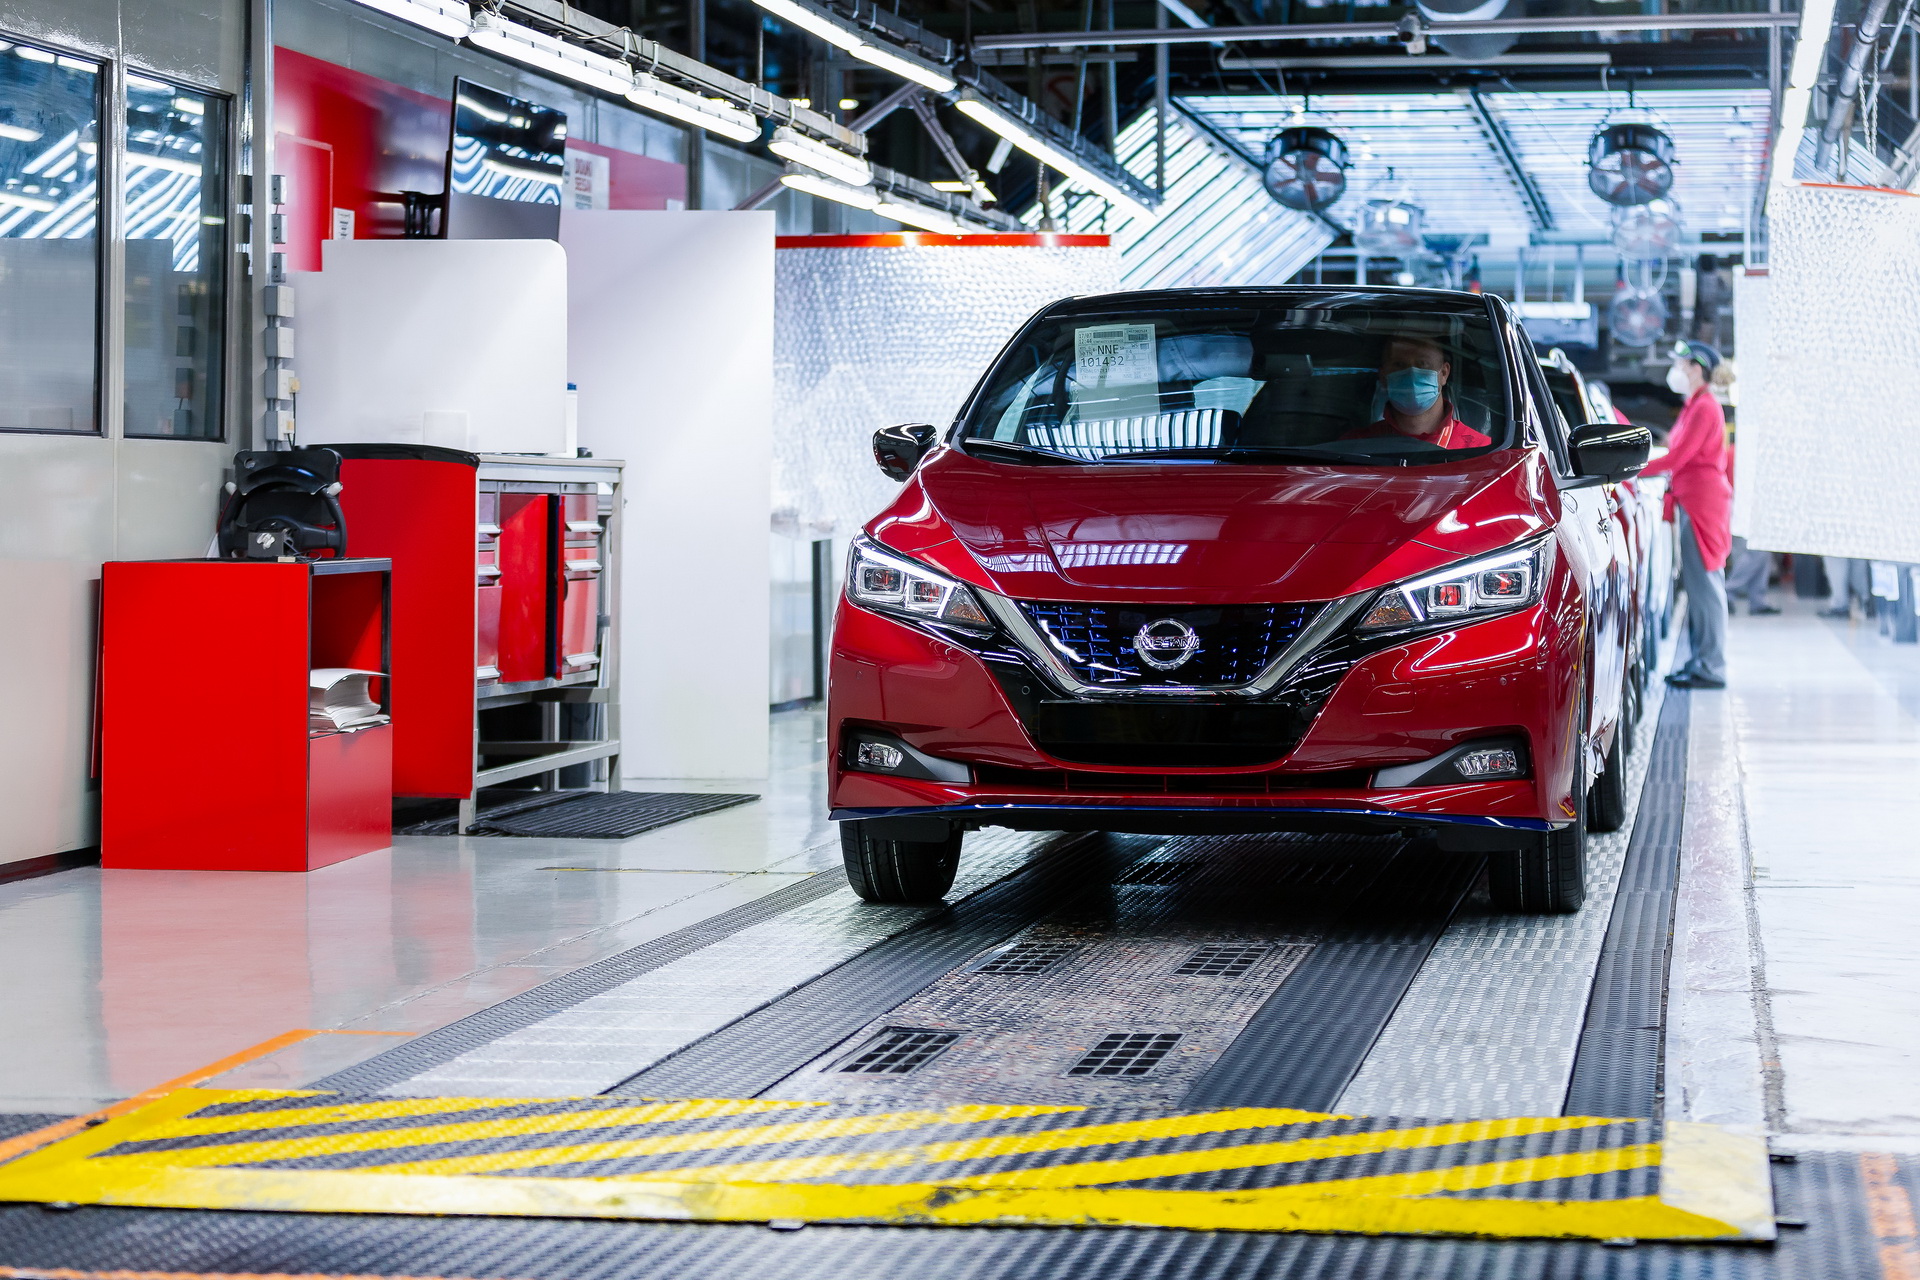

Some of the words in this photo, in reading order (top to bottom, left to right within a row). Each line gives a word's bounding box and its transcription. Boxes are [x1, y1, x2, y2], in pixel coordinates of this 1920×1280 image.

[1097, 344, 1119, 355] NNE
[1080, 355, 1125, 367] 101432
[1139, 638, 1189, 648] NISSAN
